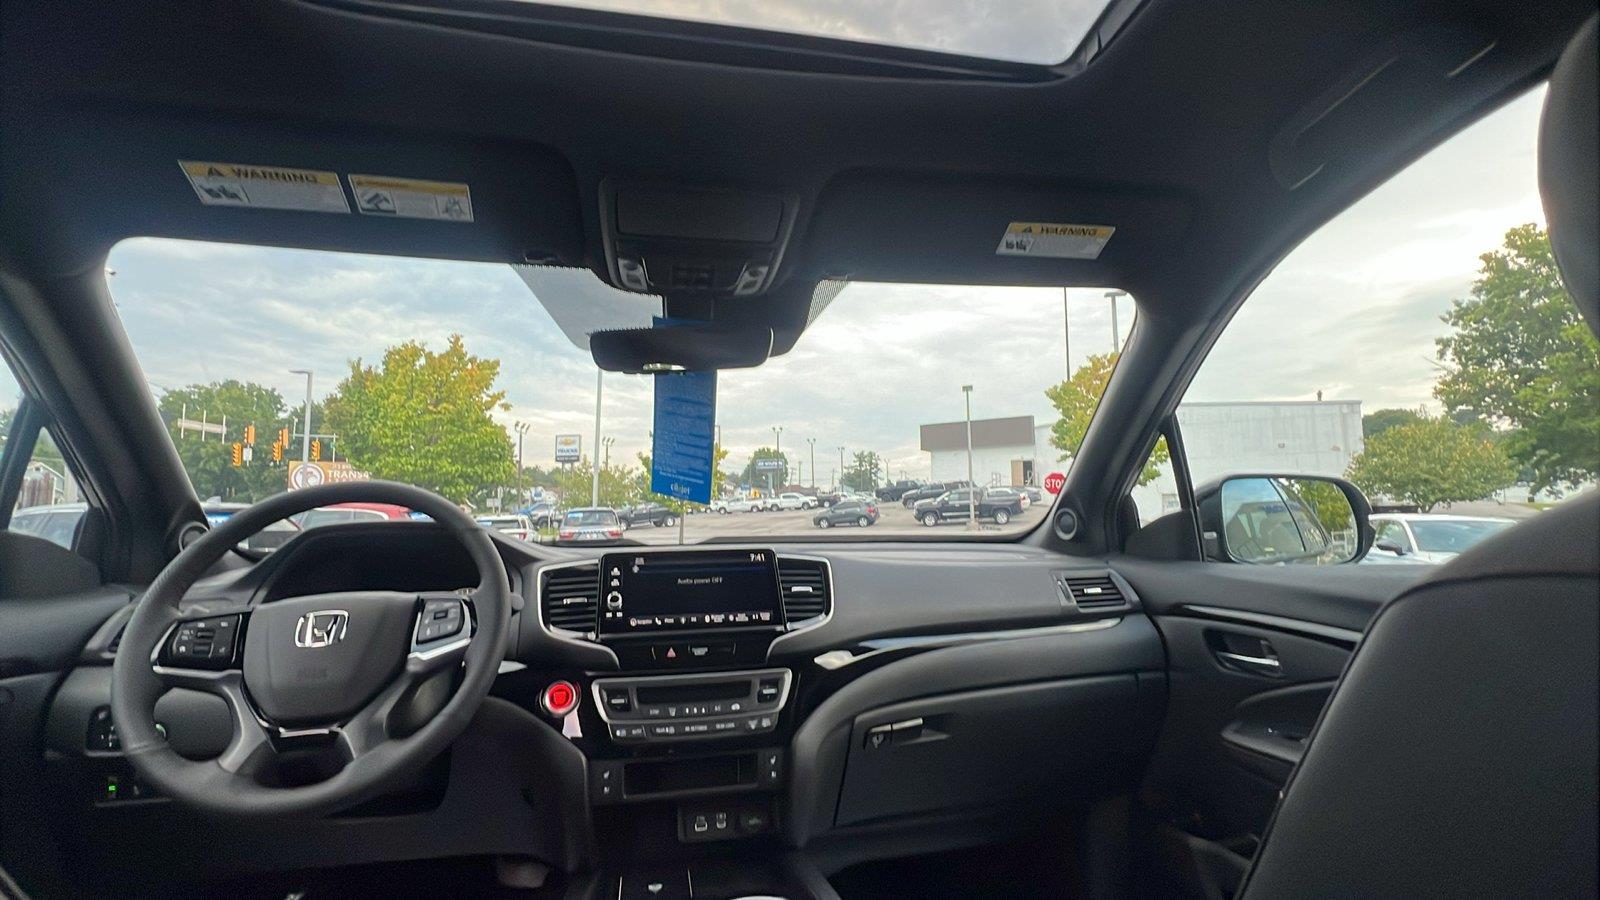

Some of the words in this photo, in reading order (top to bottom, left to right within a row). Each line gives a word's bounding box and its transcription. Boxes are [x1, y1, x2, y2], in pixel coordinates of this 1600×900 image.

[231, 166, 318, 183] WARNING
[1040, 226, 1097, 236] WARNING
[750, 553, 765, 562] 7:41
